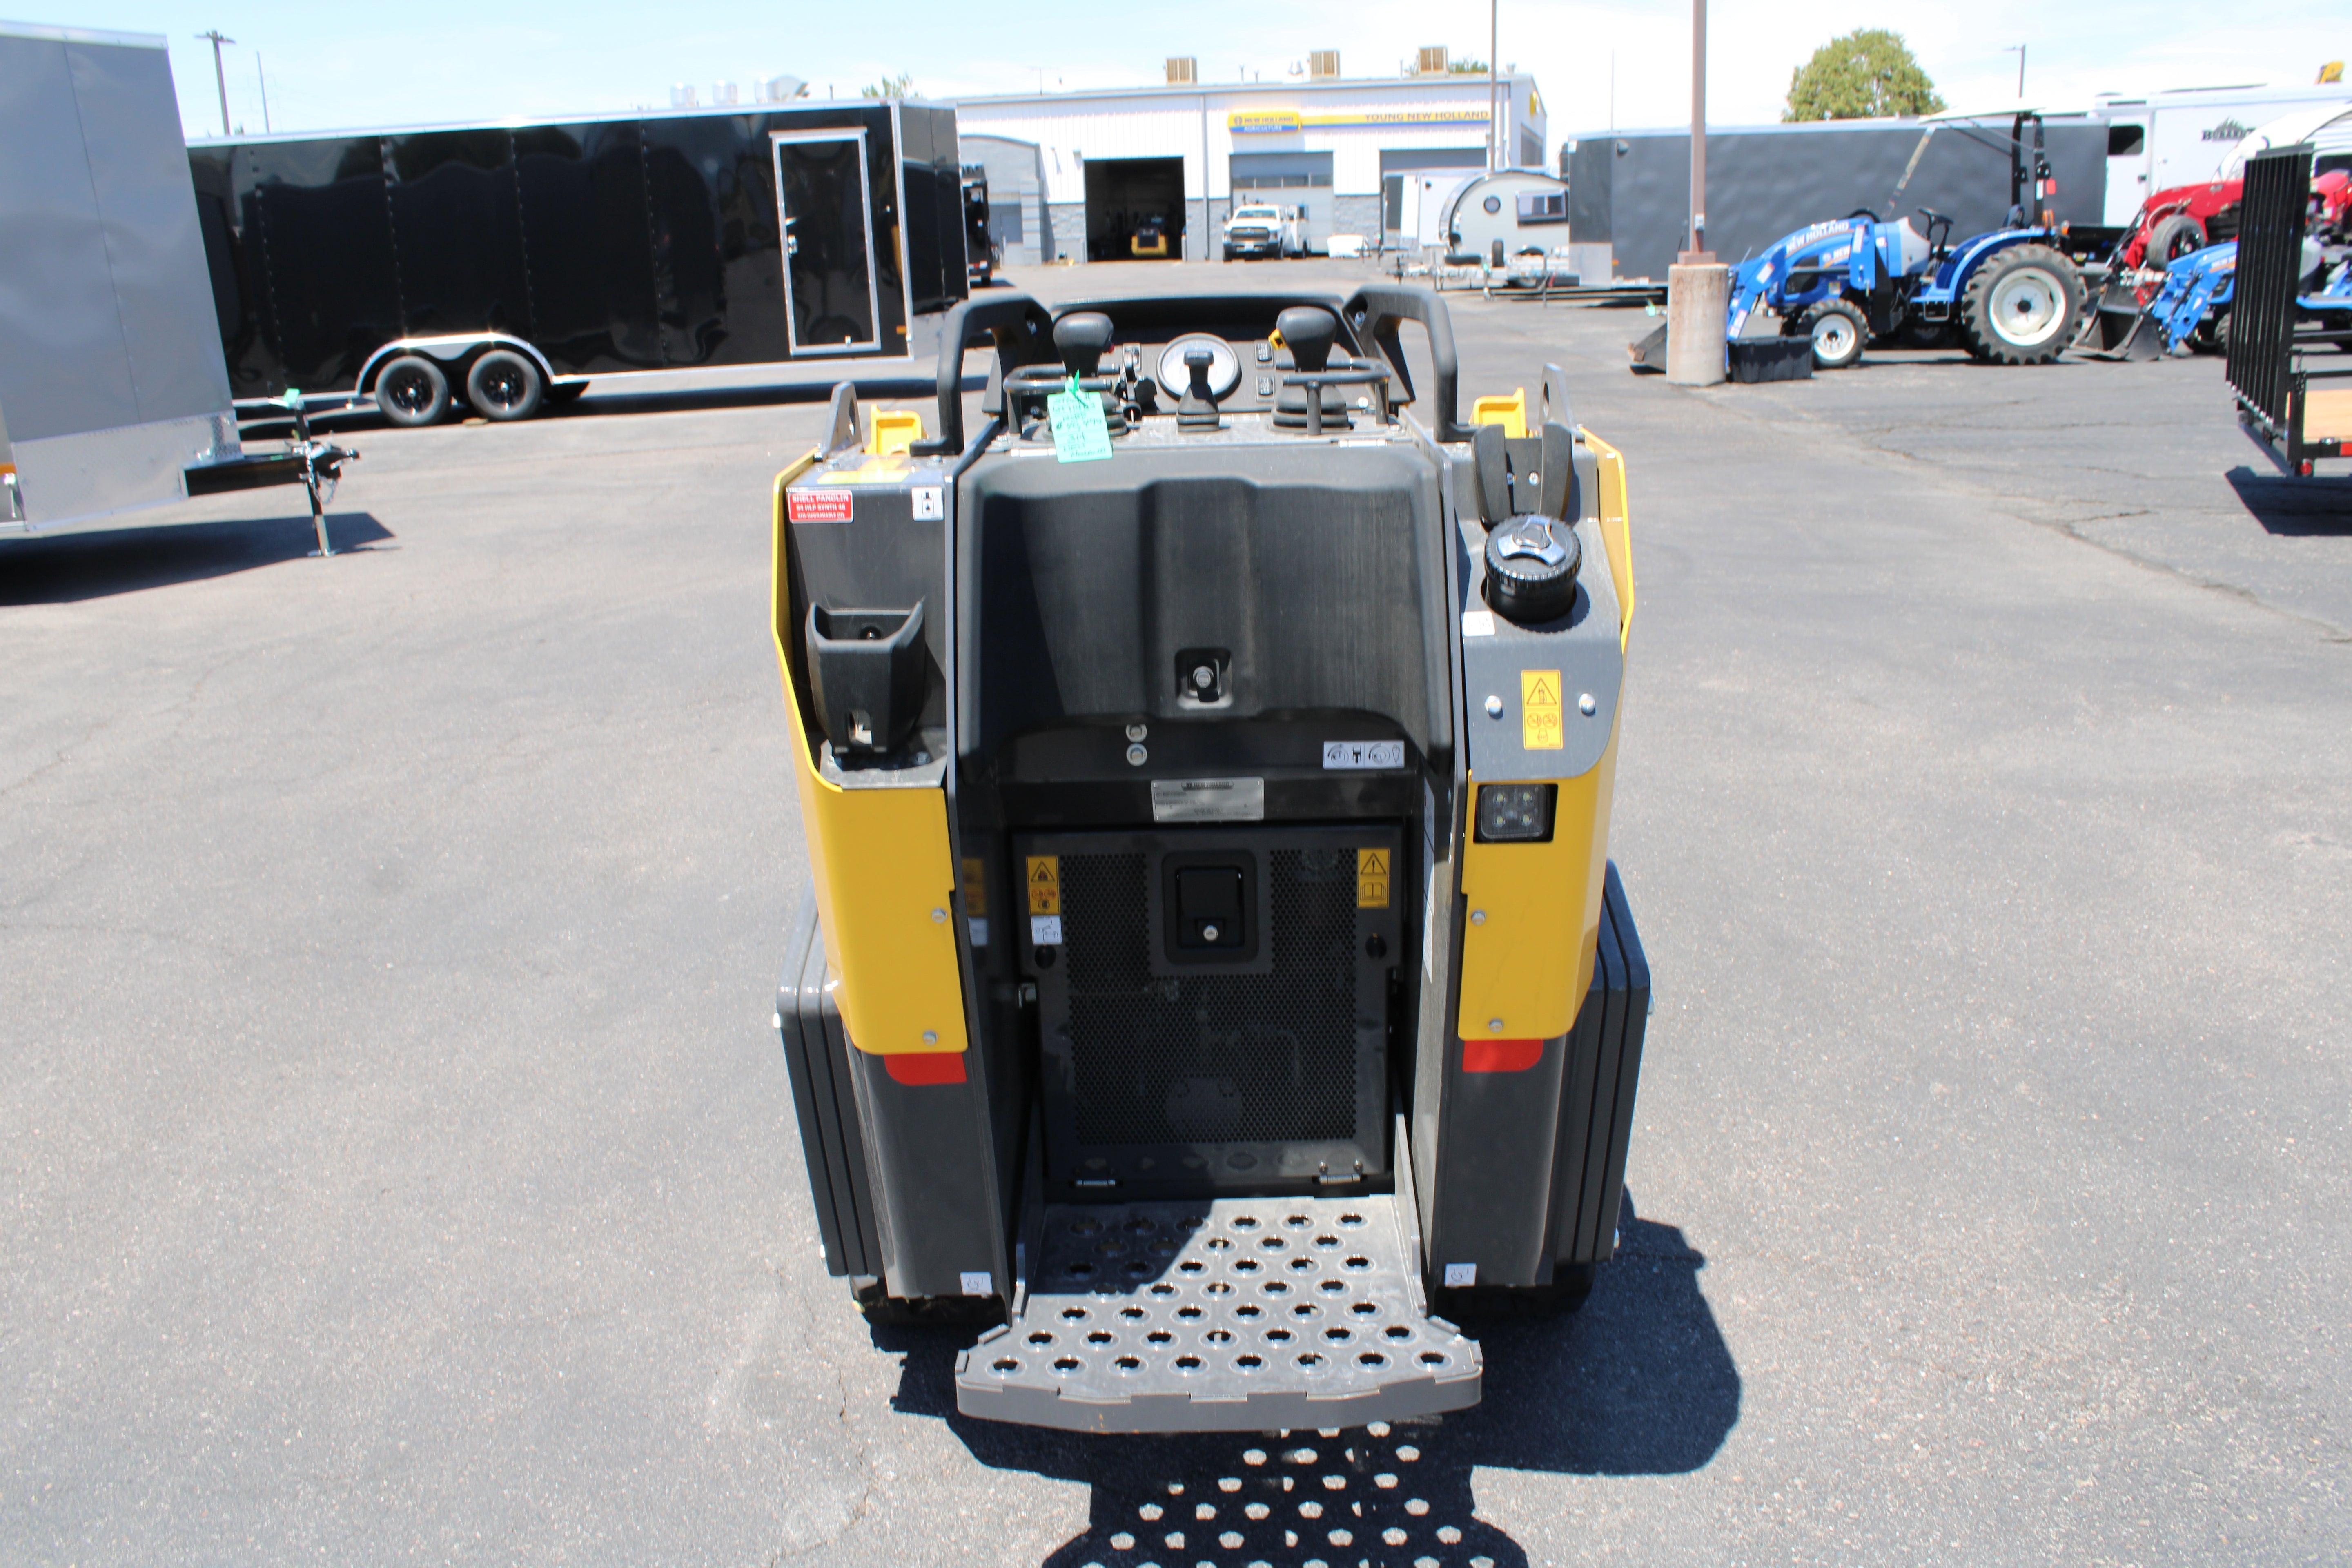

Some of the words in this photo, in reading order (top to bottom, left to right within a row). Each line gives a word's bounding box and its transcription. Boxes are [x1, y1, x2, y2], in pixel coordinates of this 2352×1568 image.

[1365, 113, 1403, 122] YOUNG
[1408, 112, 1431, 121] NEW
[1436, 111, 1488, 120] HOLLAND
[1786, 235, 1805, 254] NEW
[1806, 221, 1849, 243] HOLLAND
[1833, 245, 1851, 258] NEW
[792, 494, 815, 503] SHELL
[816, 493, 849, 502] PANOLIN
